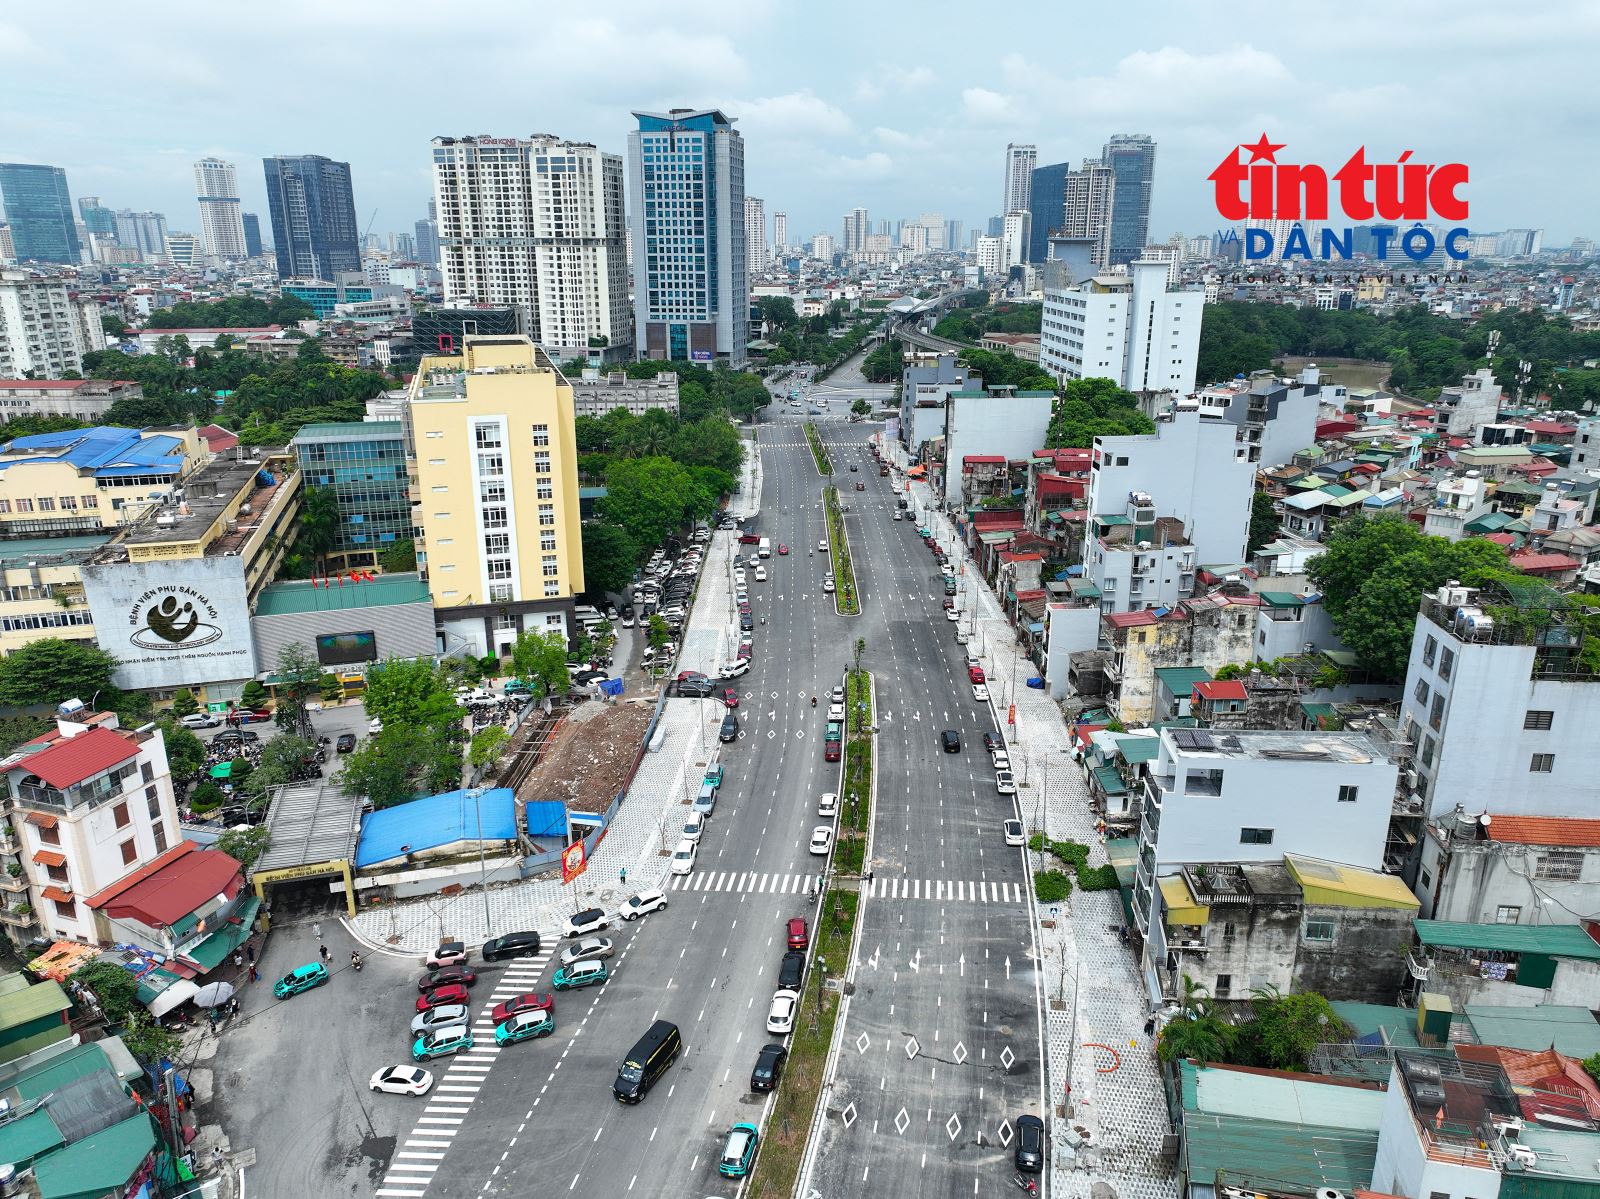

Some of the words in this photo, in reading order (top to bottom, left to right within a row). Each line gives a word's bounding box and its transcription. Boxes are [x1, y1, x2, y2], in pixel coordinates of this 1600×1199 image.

[128, 603, 142, 625] BỆNH
[137, 589, 157, 604] VIỆN
[157, 585, 176, 593] PHỤ
[178, 586, 198, 597] SẢN
[196, 594, 209, 606] HÀ
[206, 605, 218, 619] NỘI
